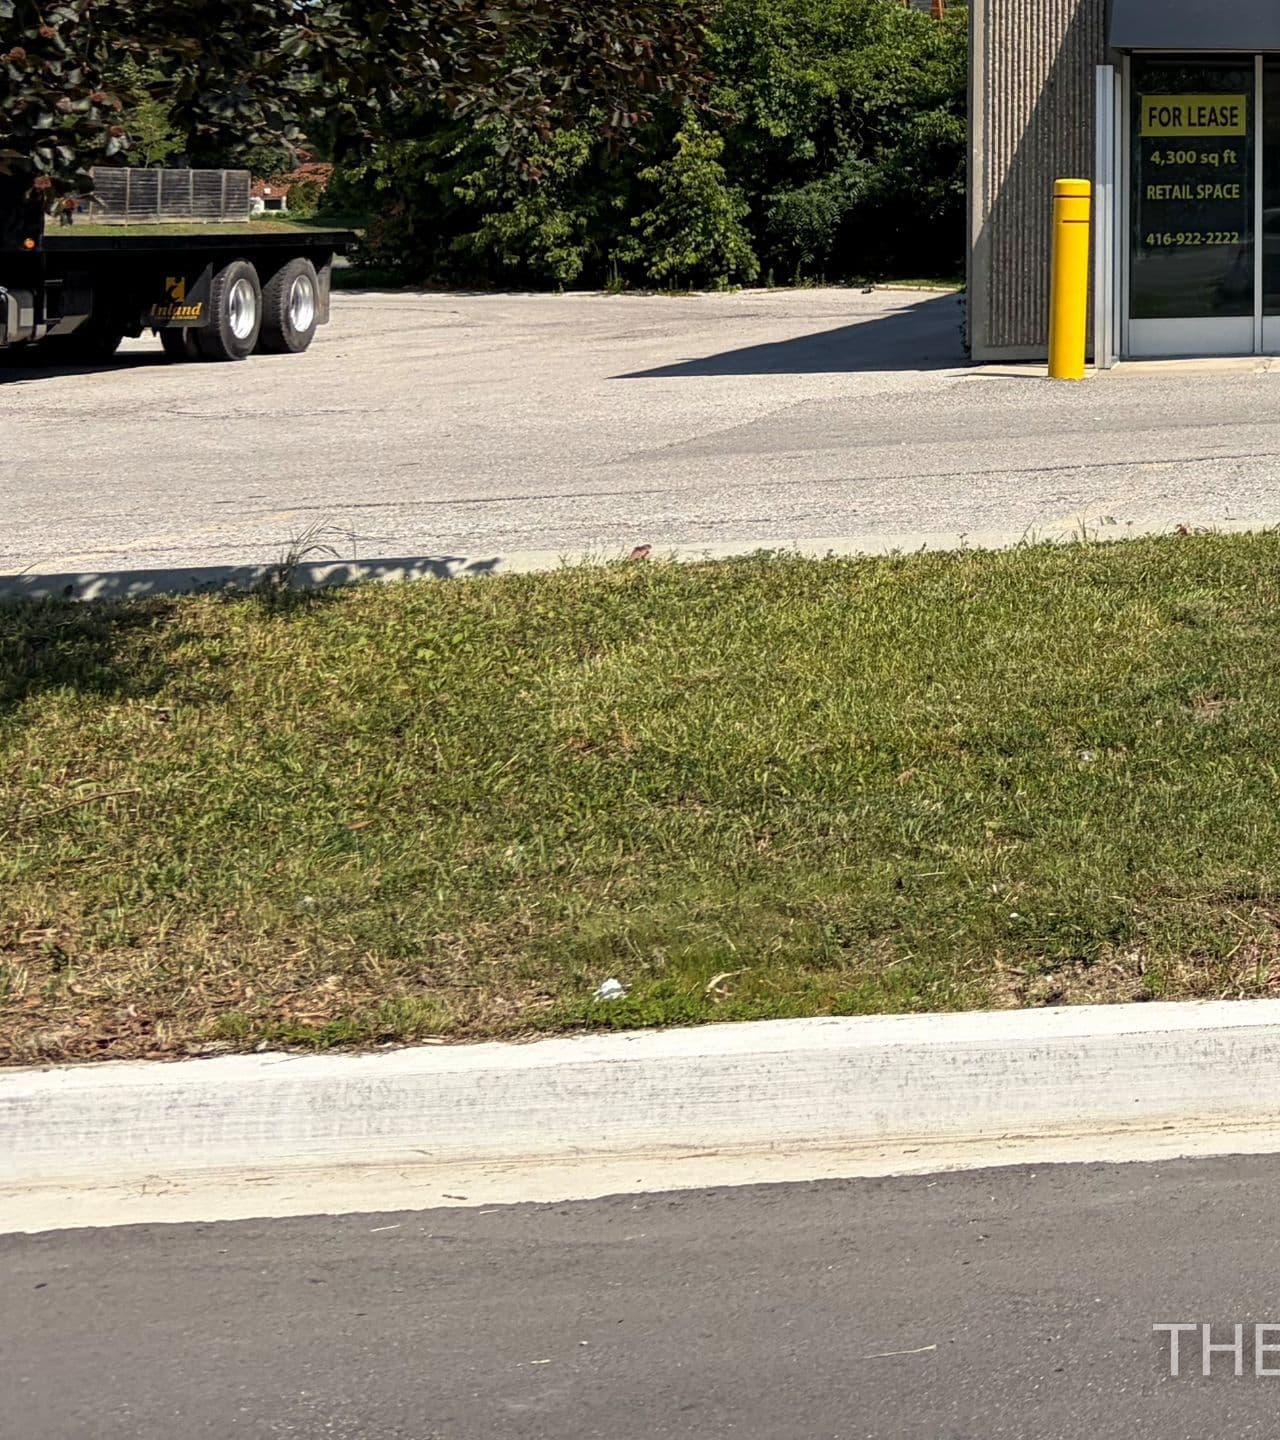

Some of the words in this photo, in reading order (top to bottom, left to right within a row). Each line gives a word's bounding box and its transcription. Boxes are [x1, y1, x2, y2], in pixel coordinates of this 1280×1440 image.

[1148, 106, 1182, 127] FOR
[1187, 106, 1239, 127] LEASE
[1150, 150, 1197, 167] 4,300
[1200, 153, 1219, 167] sq
[1223, 149, 1237, 163] ft
[1147, 185, 1194, 200] RETAIL
[1196, 184, 1240, 199] SPACE
[1145, 232, 1240, 246] 416-922-2222
[151, 302, 203, 316] Inland
